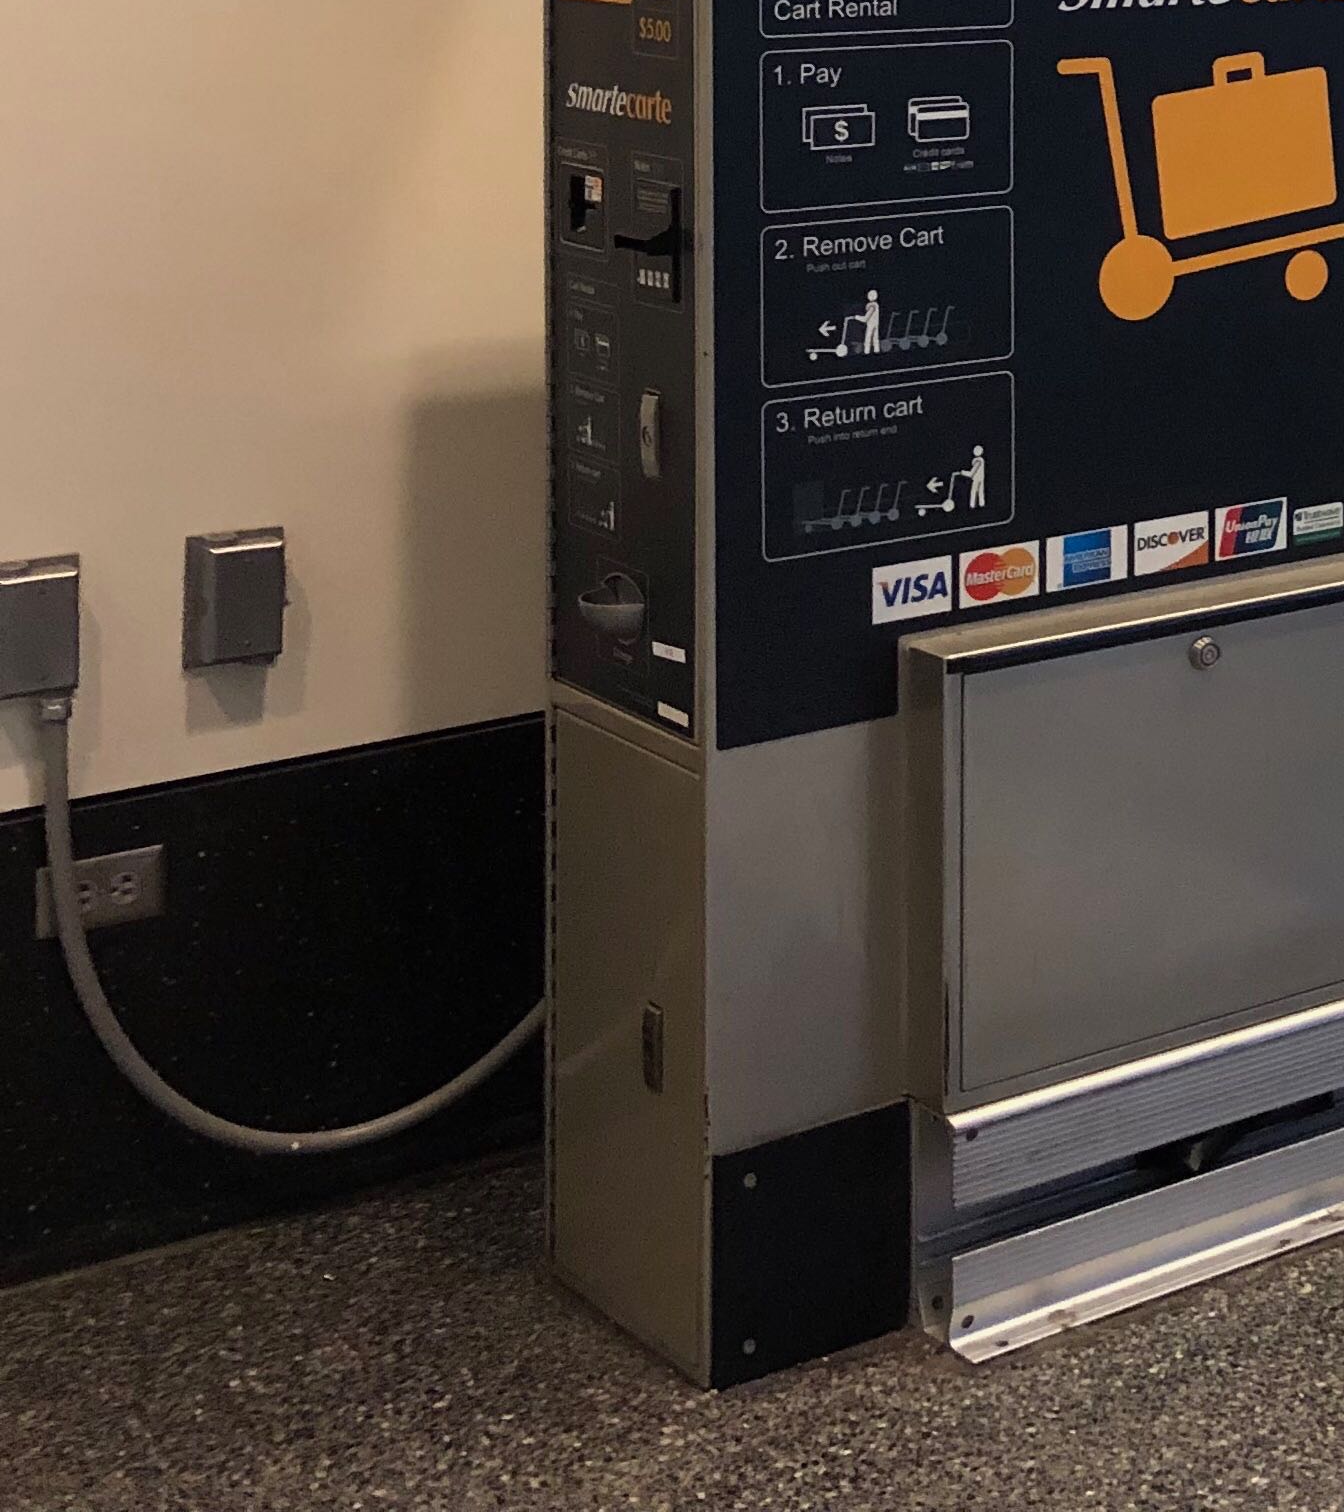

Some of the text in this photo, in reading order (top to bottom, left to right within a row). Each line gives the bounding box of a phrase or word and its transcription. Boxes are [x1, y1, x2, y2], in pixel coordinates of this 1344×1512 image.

[773, 0, 821, 21] Cart
[773, 63, 842, 88] 1. Pay
[565, 82, 673, 125] smartecarte
[774, 225, 945, 260] 2. Remove Cart
[806, 262, 830, 273] Push
[775, 395, 924, 433] 3. Return cart
[1137, 527, 1205, 551] DISCOVER
[966, 564, 1035, 587] MasterCard
[877, 571, 949, 608] VISA
